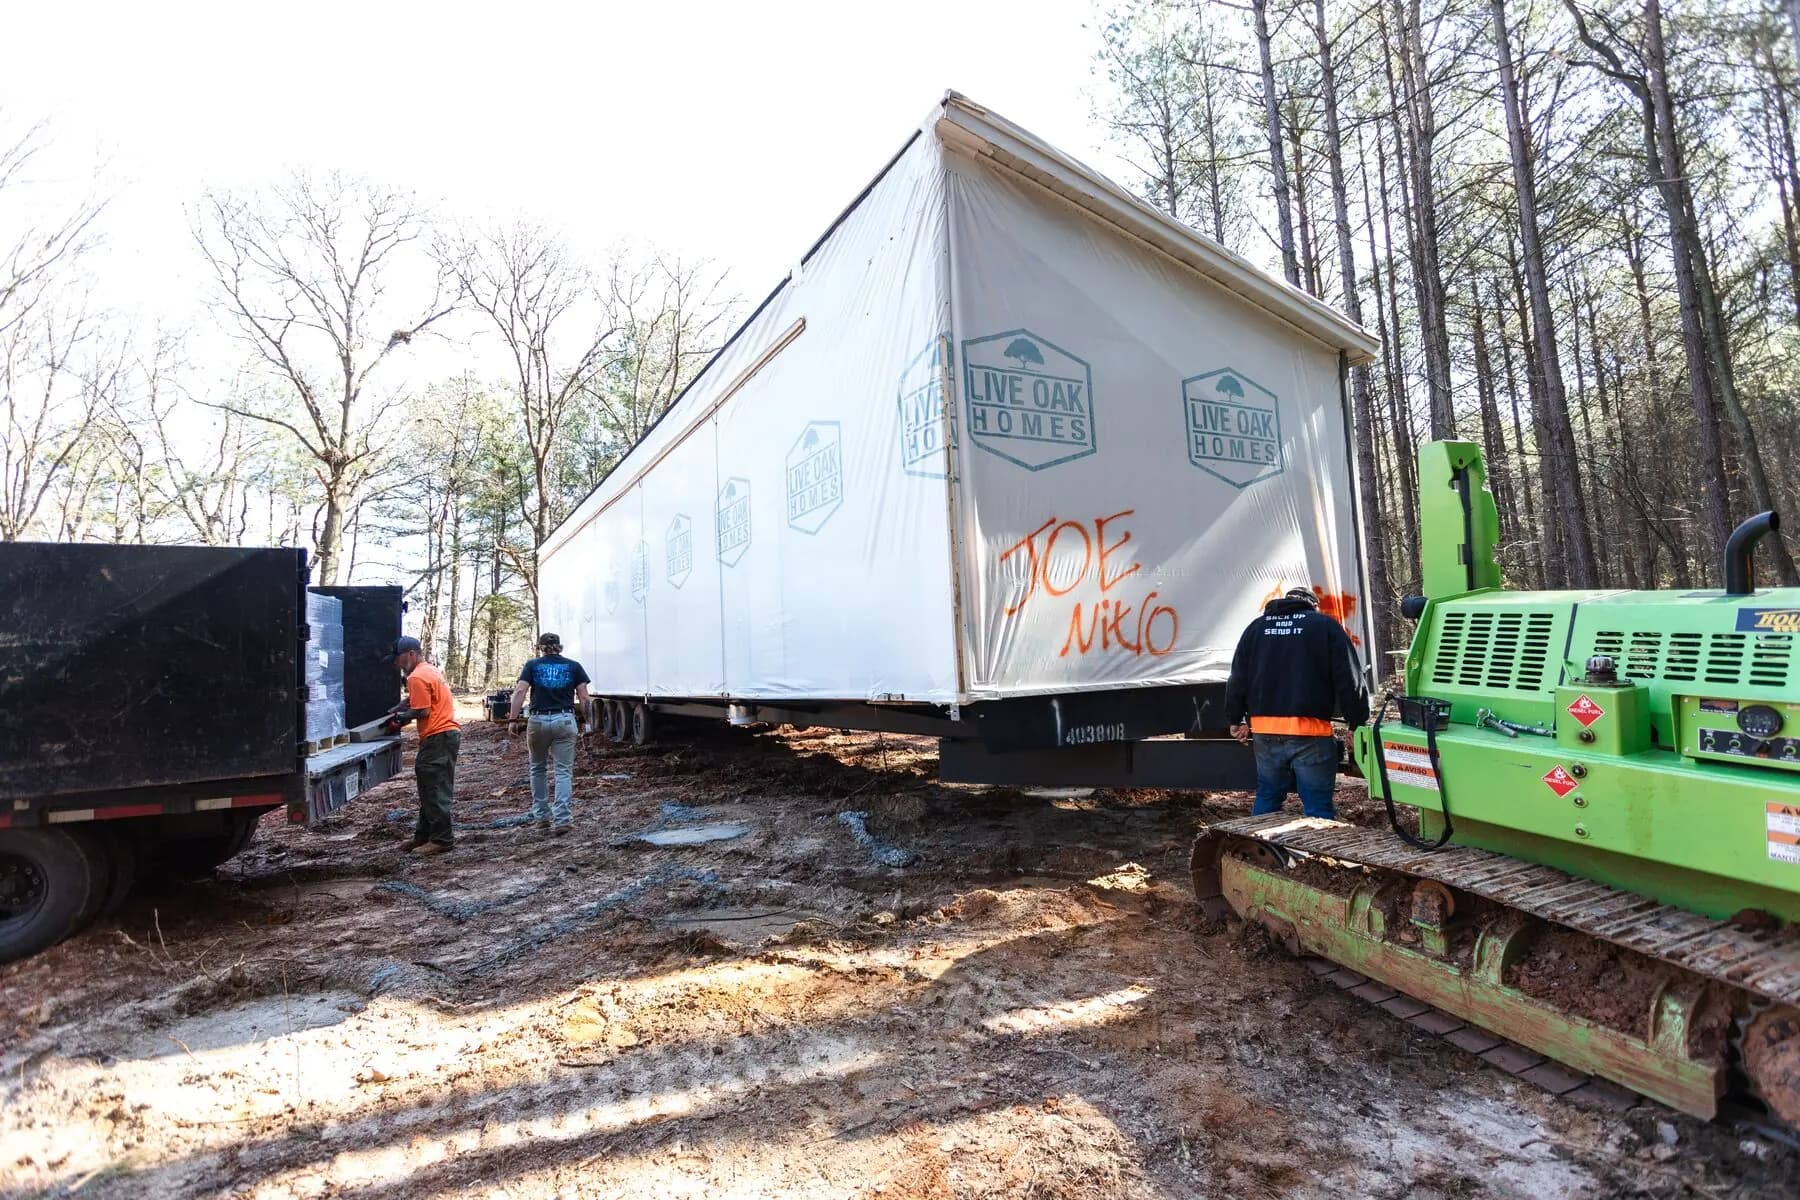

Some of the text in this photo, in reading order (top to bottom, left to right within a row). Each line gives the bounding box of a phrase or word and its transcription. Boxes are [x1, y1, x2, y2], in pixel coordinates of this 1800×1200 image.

[905, 384, 945, 426] LIVE
[969, 370, 1085, 413] LIVE OAK
[972, 408, 1086, 441] HOMES
[1191, 403, 1274, 438] LIVE OAK
[1195, 435, 1275, 462] HOMES
[790, 446, 838, 494] LIVE OAK
[790, 477, 838, 517] HOMES
[720, 524, 749, 550] OMES
[1000, 509, 1141, 616] JOE
[1756, 612, 1800, 627] HOU
[1398, 744, 1430, 755] WARNIN
